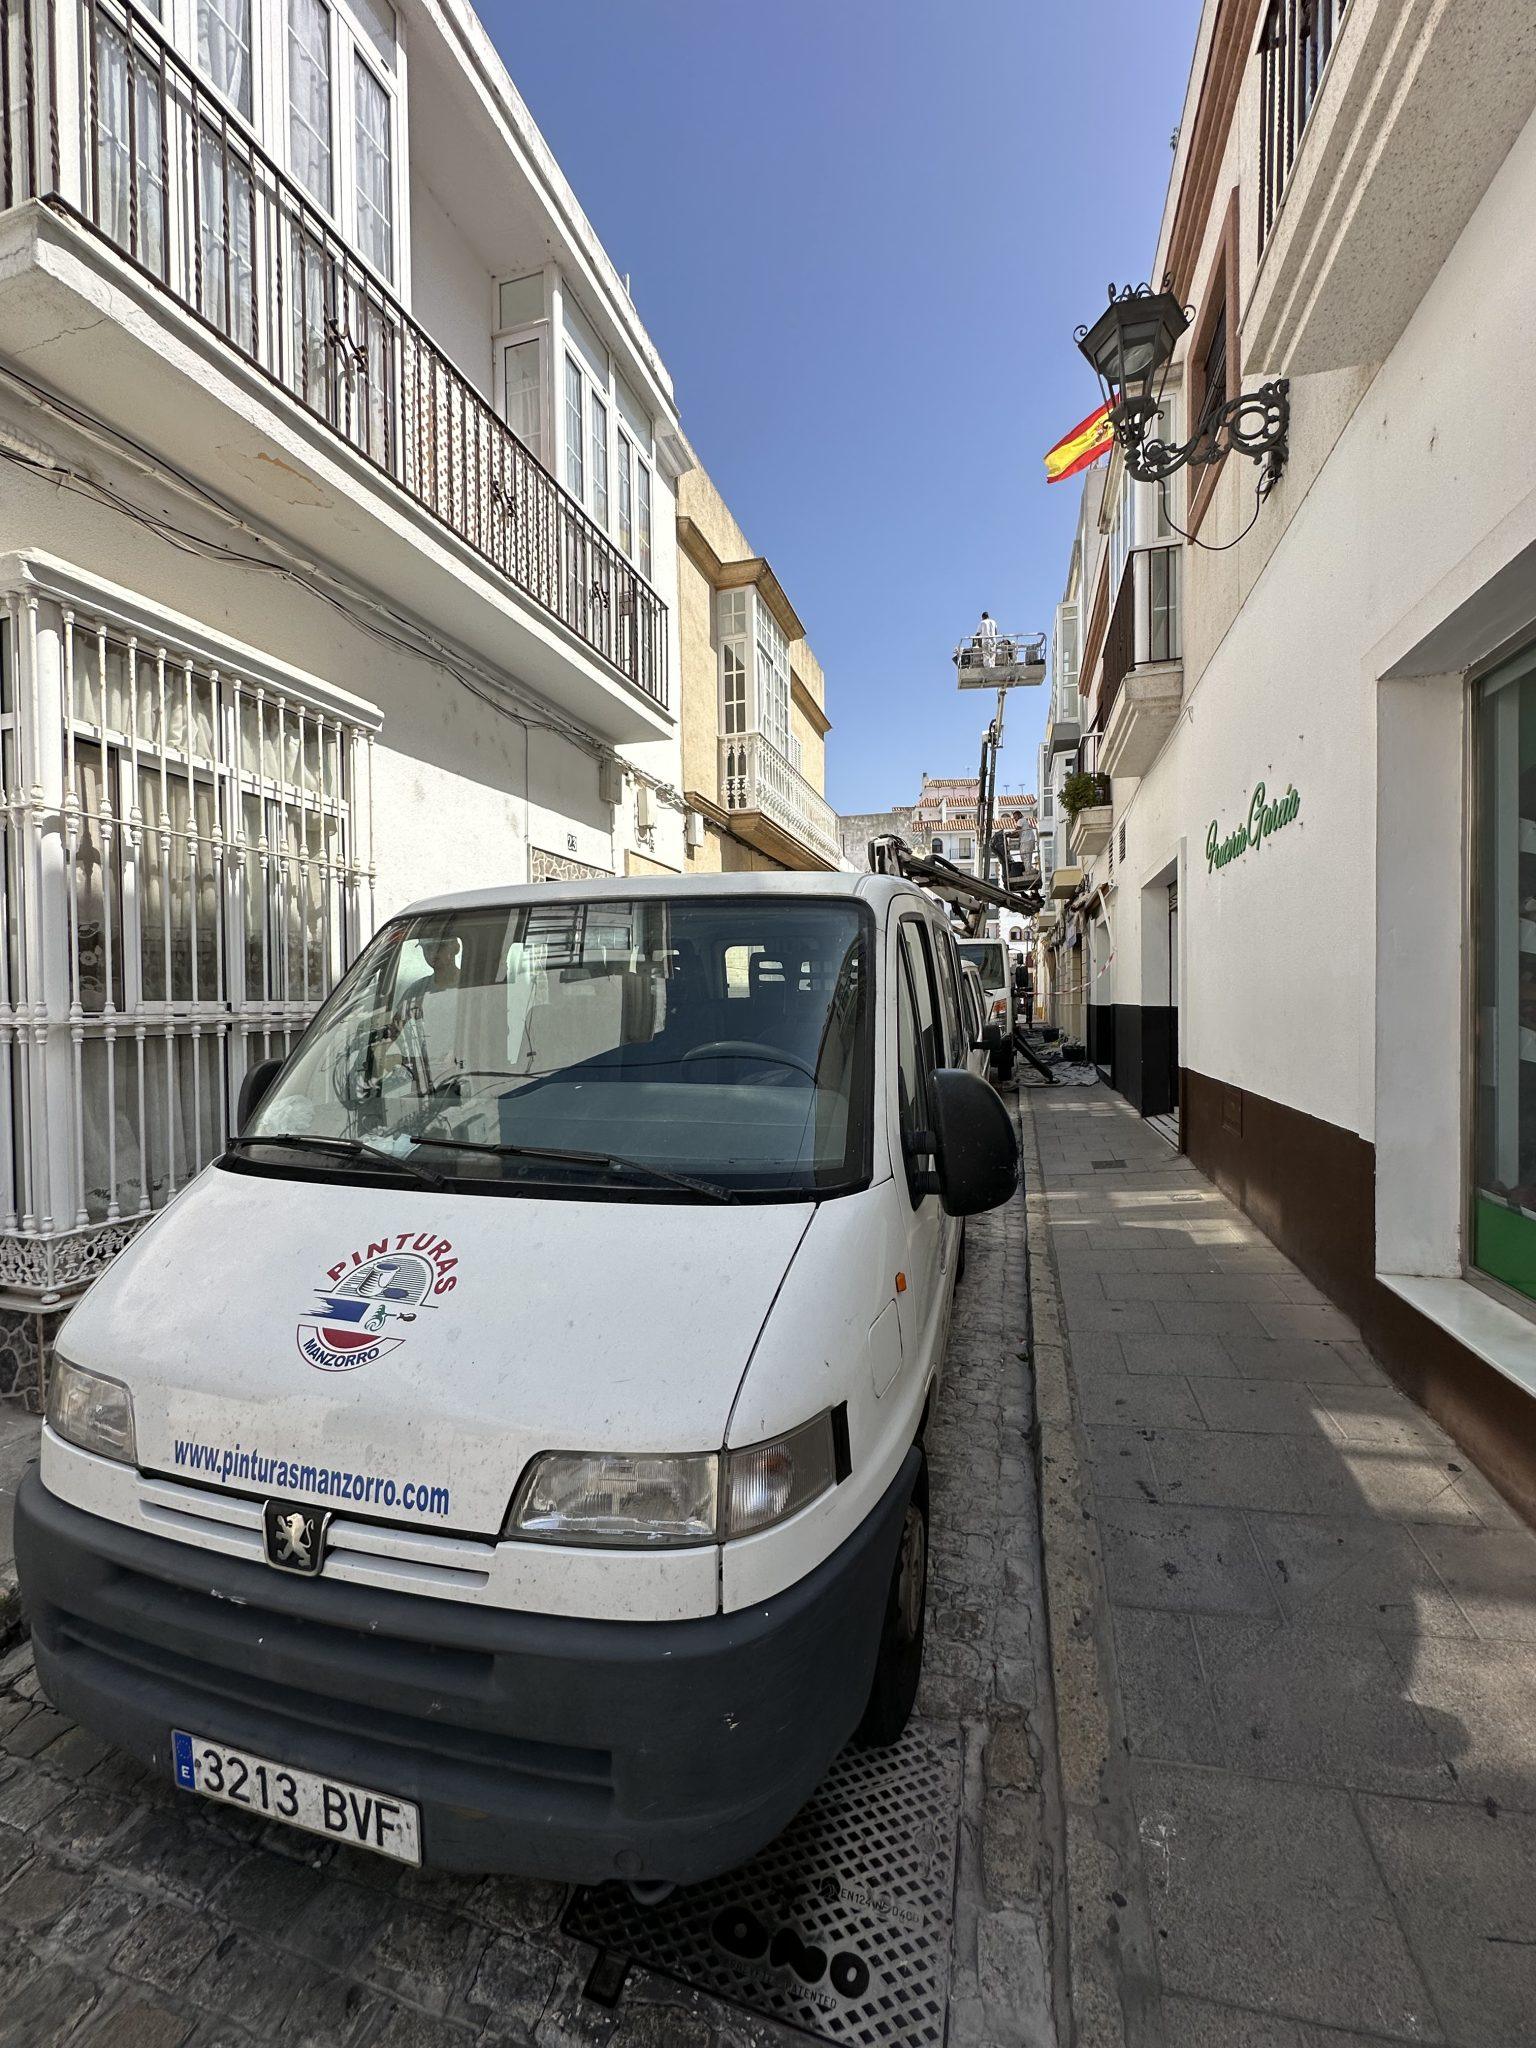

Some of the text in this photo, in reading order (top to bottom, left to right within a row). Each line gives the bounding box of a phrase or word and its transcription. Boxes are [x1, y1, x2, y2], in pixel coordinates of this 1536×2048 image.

[326, 1232, 459, 1295] PINTURAS
[302, 1338, 380, 1368] MANZORRO
[174, 1440, 450, 1515] www.pinturasmanzorro.com
[181, 1766, 191, 1779] E
[203, 1749, 400, 1846] 3213 BVF
[783, 1979, 838, 2009] PATENTED
